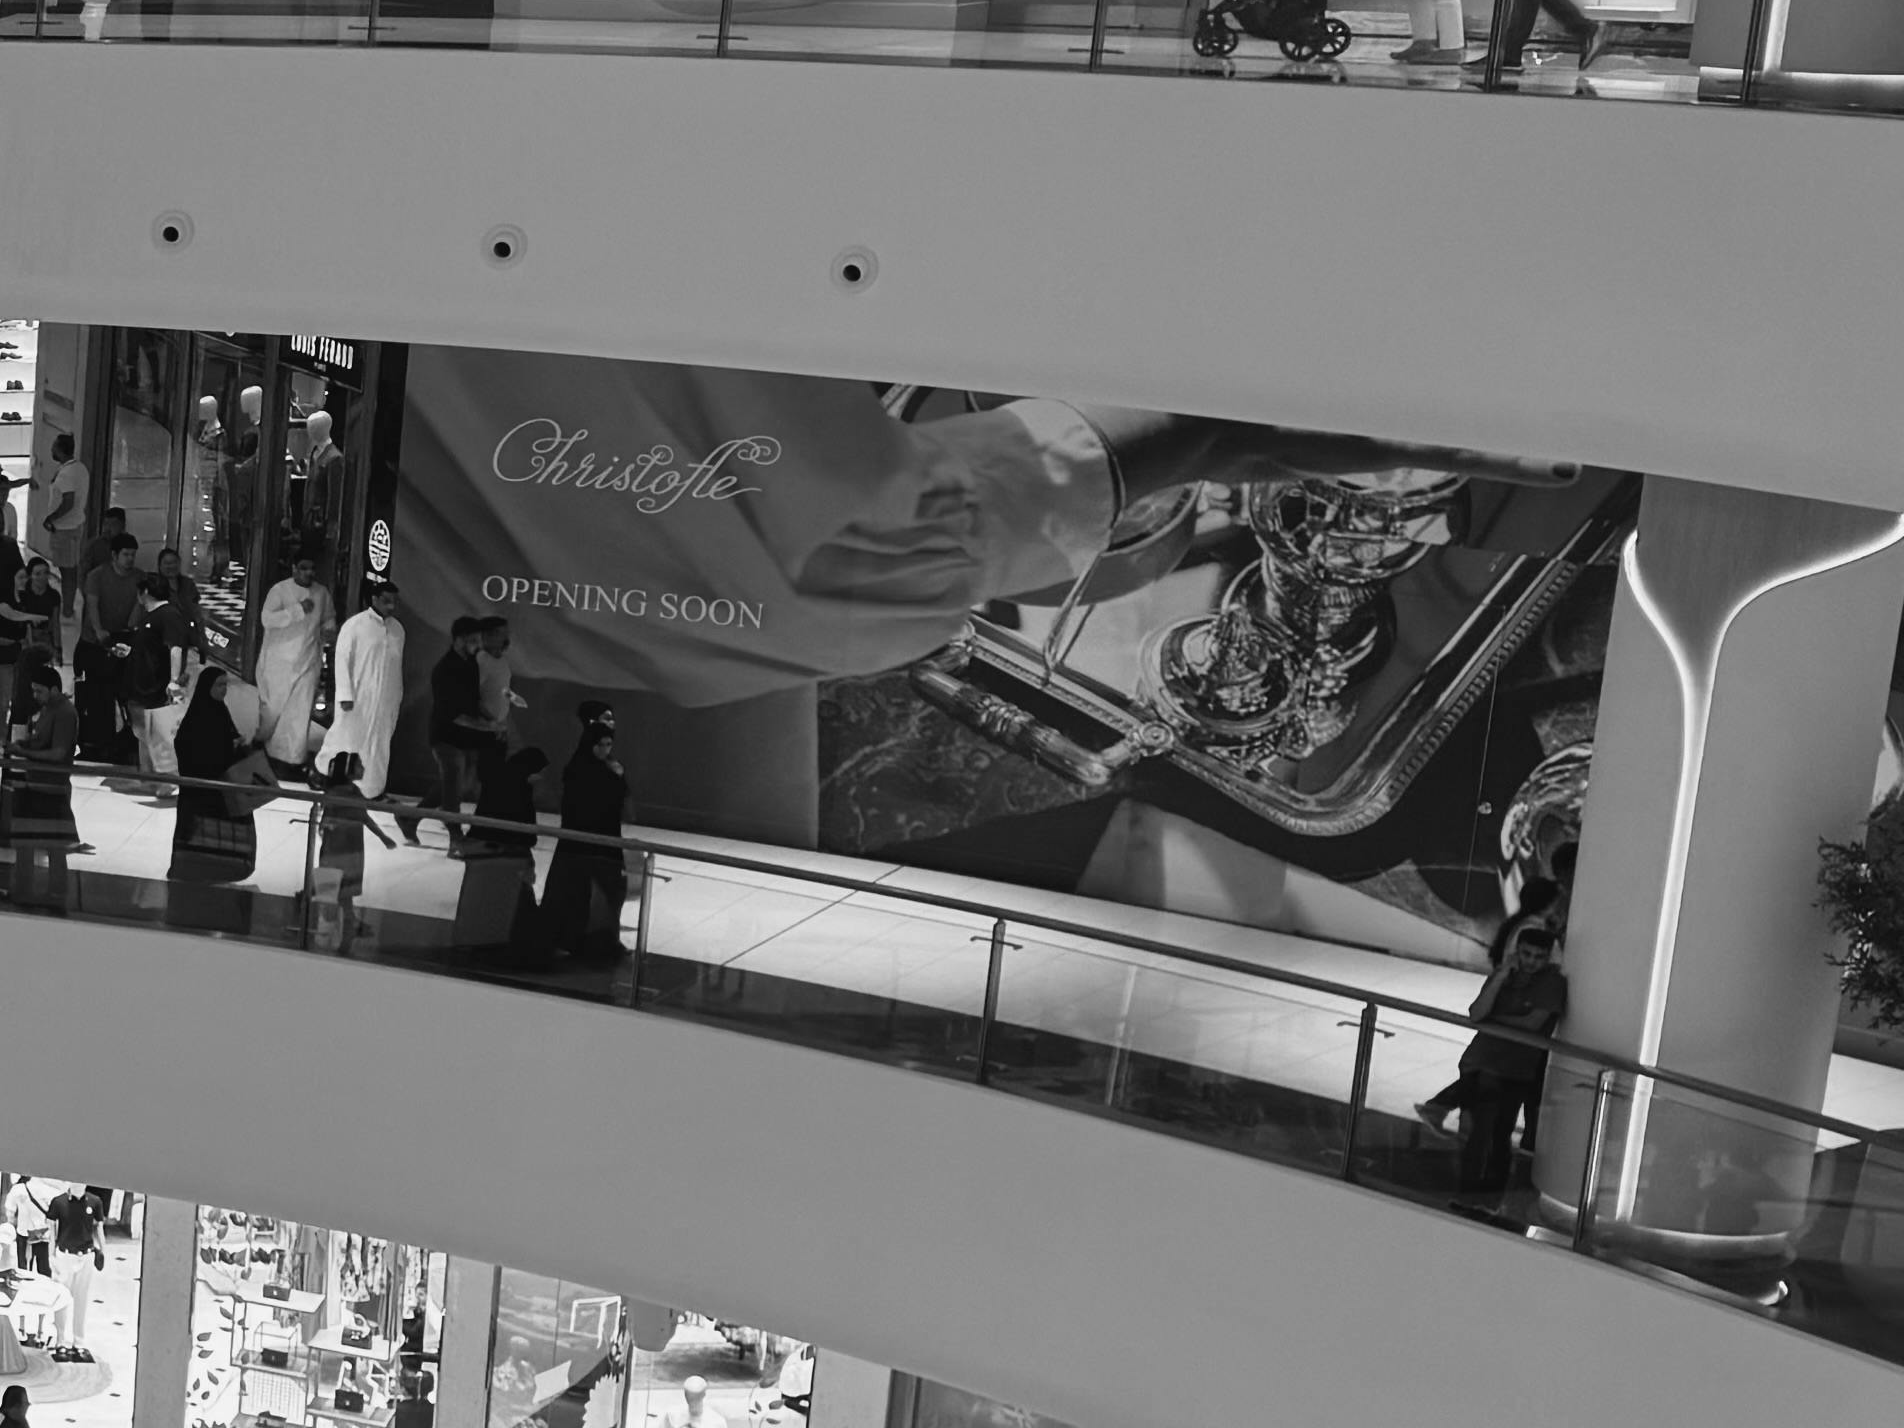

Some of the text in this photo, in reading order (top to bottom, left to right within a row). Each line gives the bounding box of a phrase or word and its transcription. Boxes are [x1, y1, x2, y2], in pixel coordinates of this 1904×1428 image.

[319, 336, 353, 369] FERAUD
[493, 418, 782, 514] Christofle
[482, 575, 764, 629] OPENING SOON
